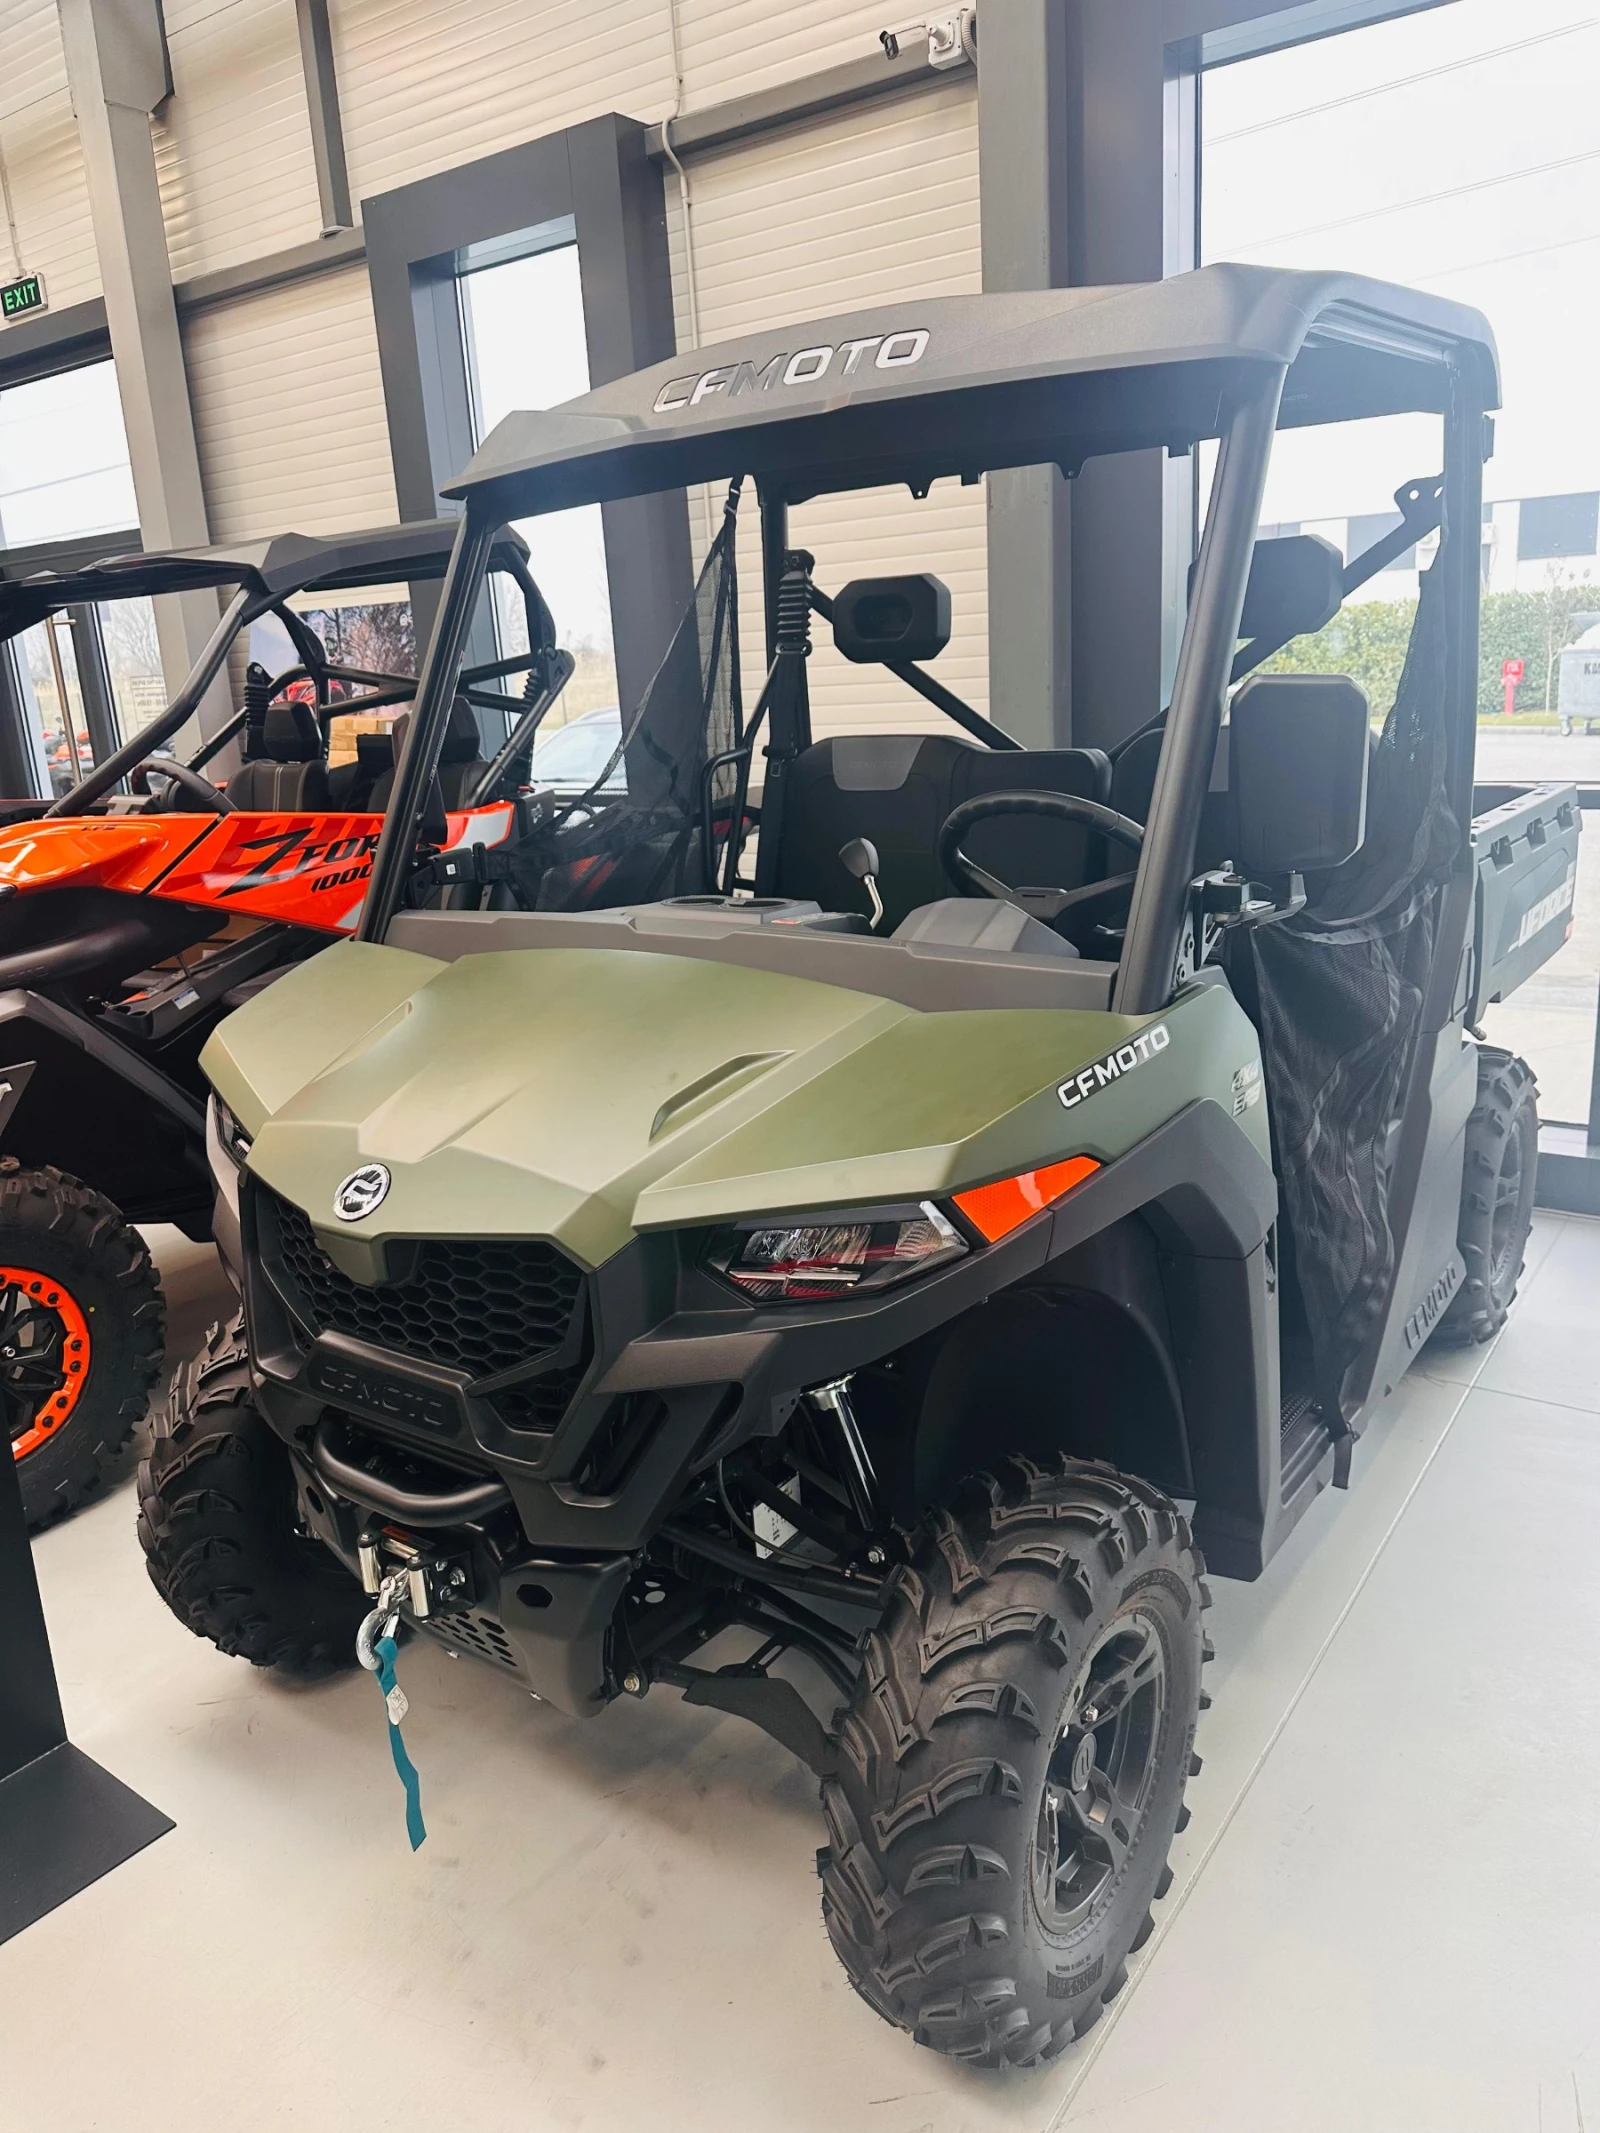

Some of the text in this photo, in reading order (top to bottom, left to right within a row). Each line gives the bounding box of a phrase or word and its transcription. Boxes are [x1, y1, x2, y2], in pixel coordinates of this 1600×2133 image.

[4, 282, 36, 311] EXIT
[652, 328, 931, 413] CFMOTO
[1057, 1024, 1170, 1107] CFMOTO
